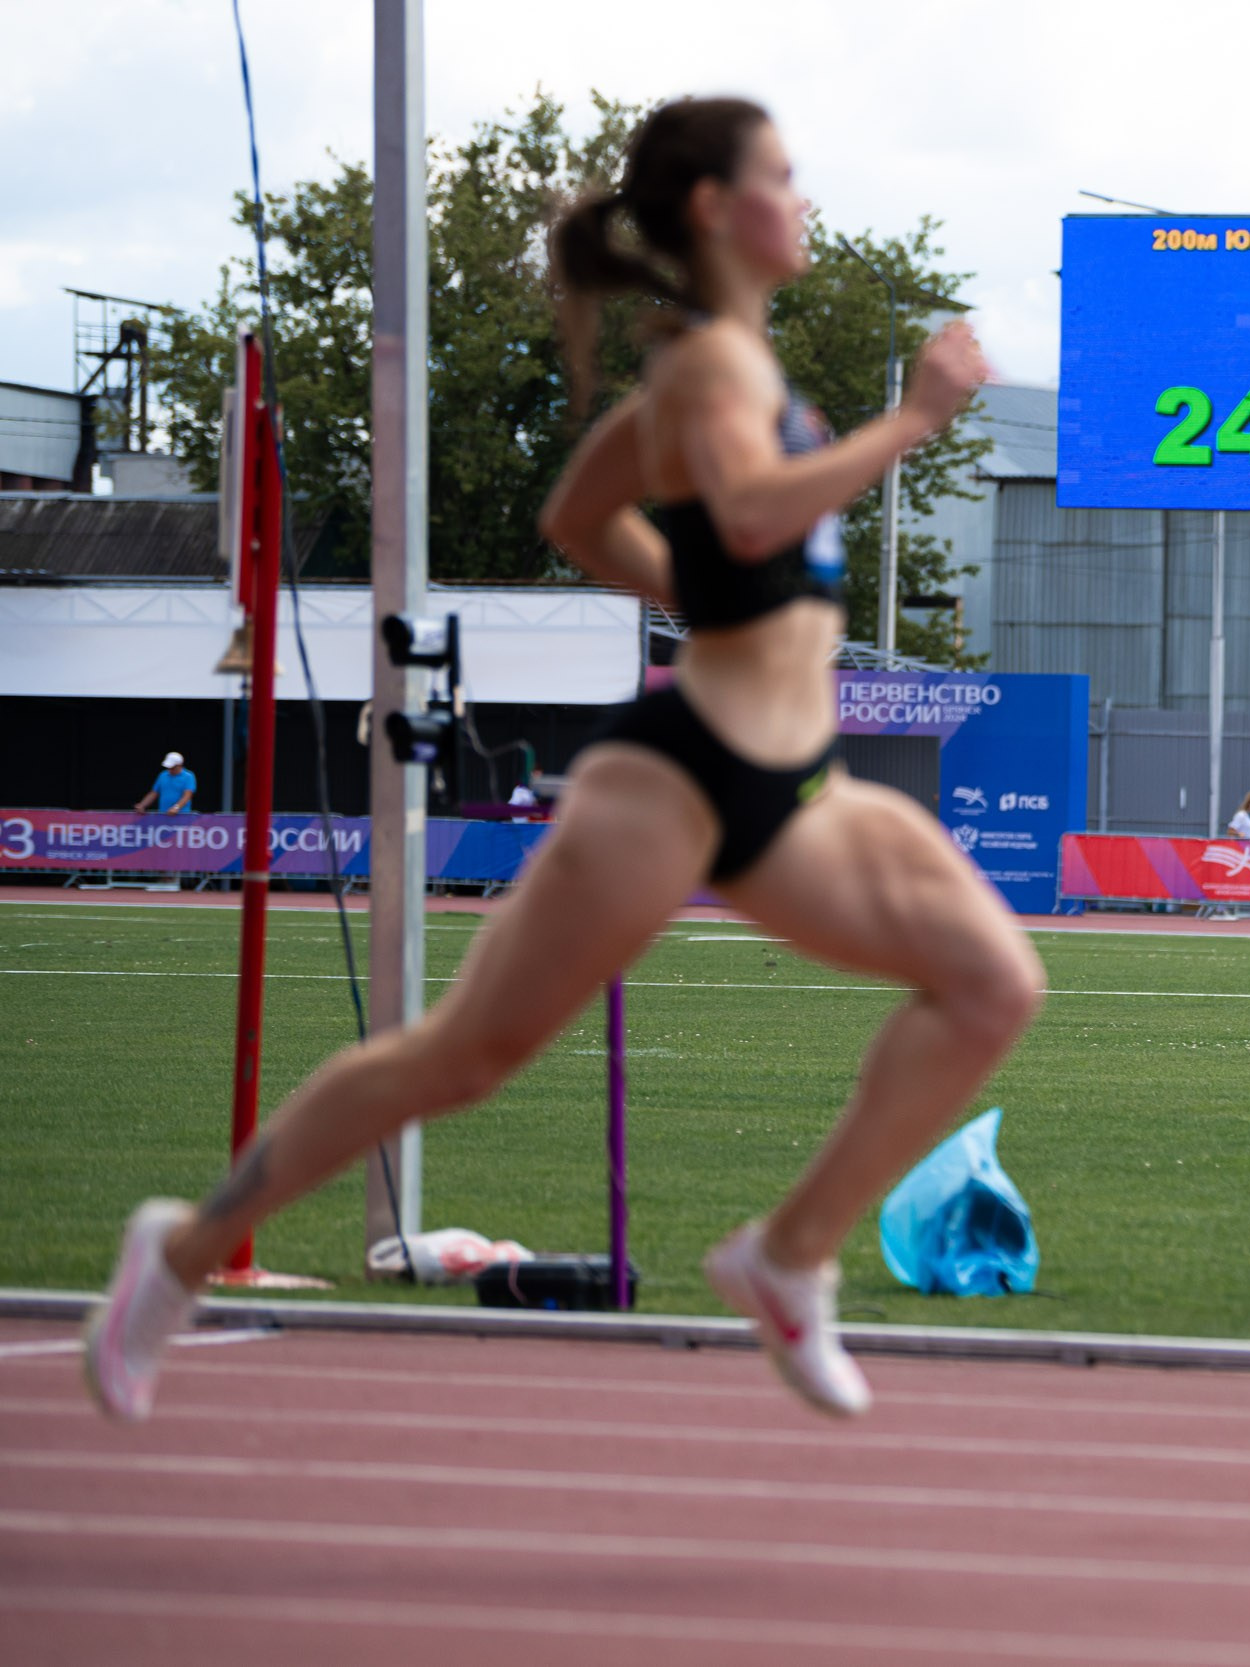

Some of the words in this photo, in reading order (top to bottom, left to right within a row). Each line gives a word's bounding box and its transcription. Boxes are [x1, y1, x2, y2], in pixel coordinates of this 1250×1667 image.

[1152, 229, 1218, 251] 200м
[840, 682, 1002, 706] ПЕРВЕНСТВО
[840, 703, 941, 724] РОССИИ
[1018, 794, 1050, 811] ПСБ
[0, 816, 35, 860] 3
[47, 823, 230, 850] ПЕРВЕНСТВО
